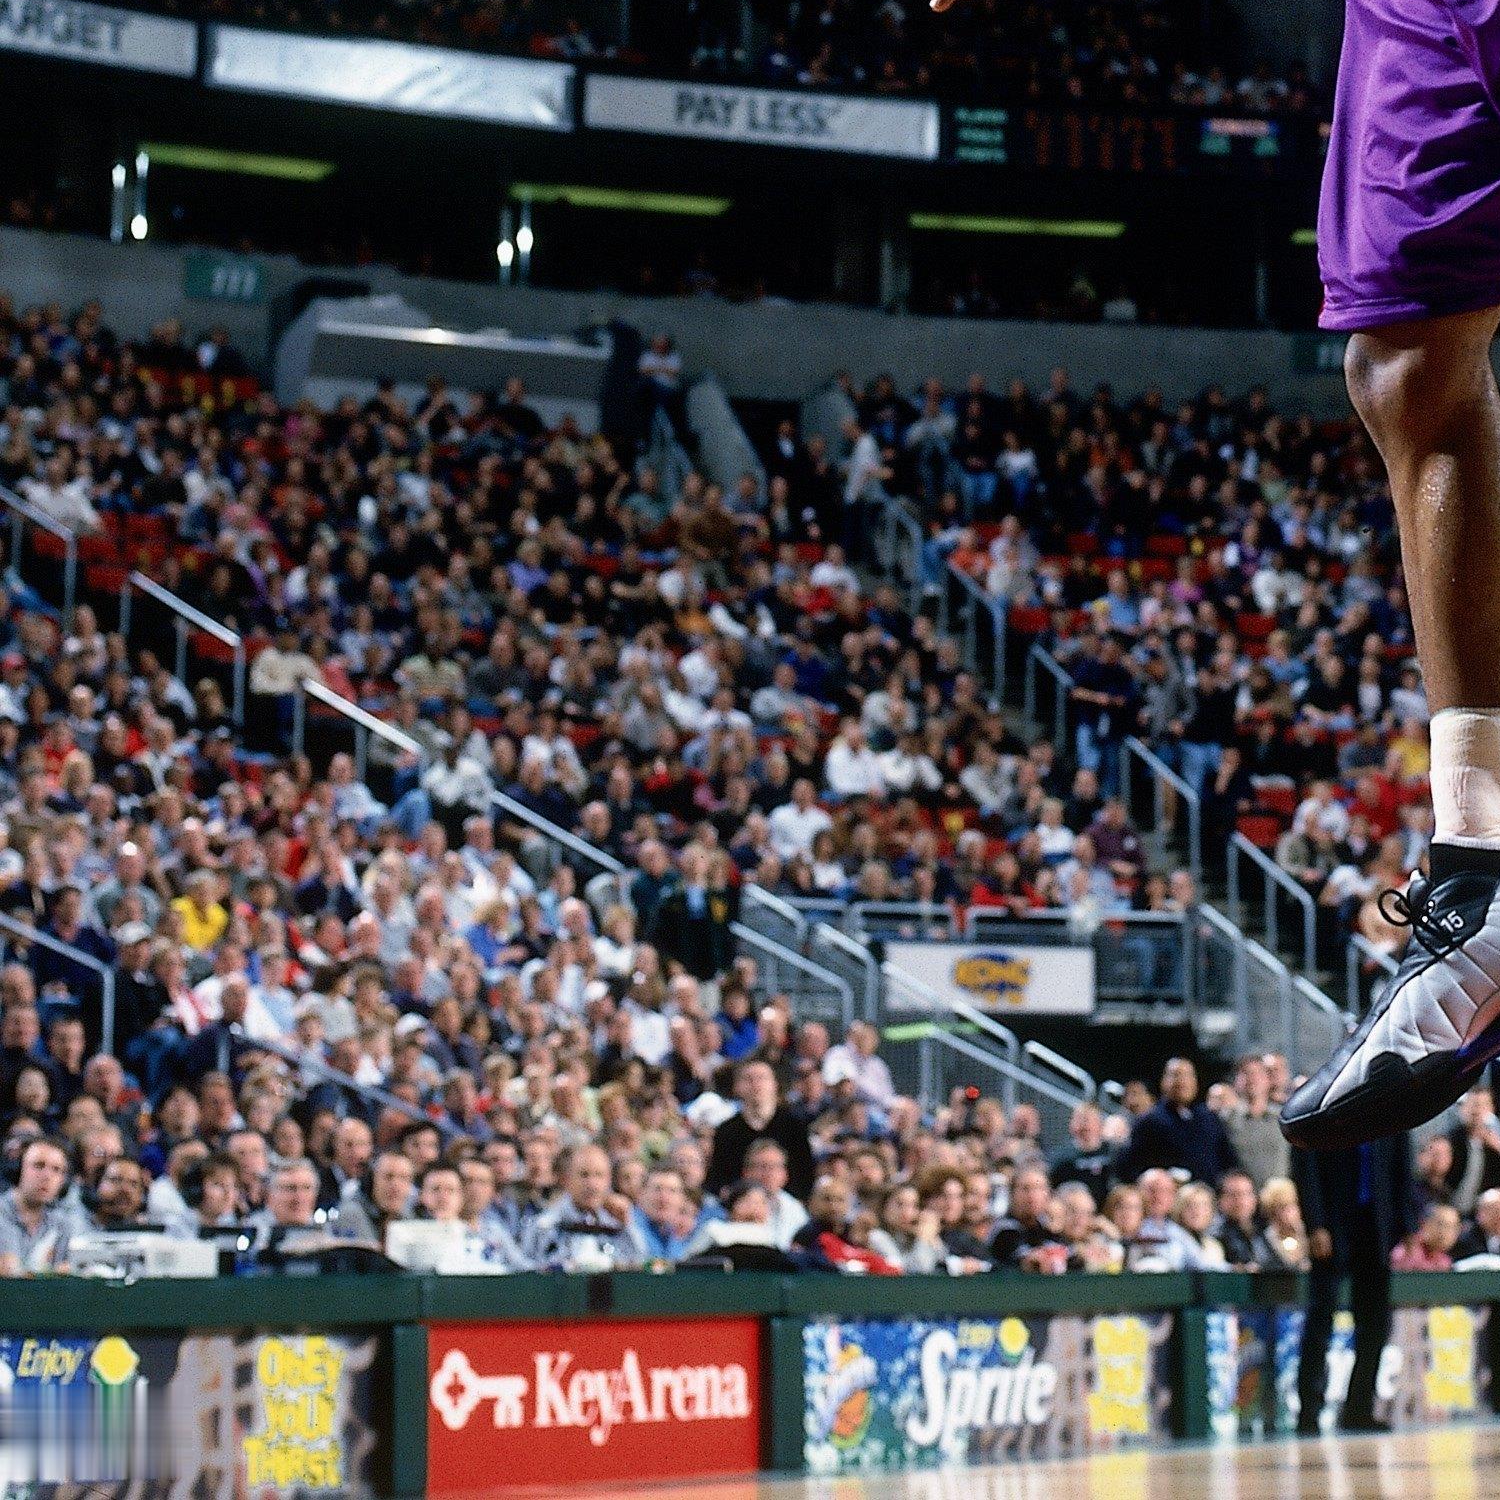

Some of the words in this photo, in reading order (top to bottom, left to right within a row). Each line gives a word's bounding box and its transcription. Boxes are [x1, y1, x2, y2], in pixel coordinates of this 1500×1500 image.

[675, 90, 738, 126] PAY
[1439, 908, 1465, 934] 15
[17, 1339, 84, 1385] Enjoy
[533, 1347, 752, 1446] KeyArena
[905, 1328, 1059, 1462] Sprite
